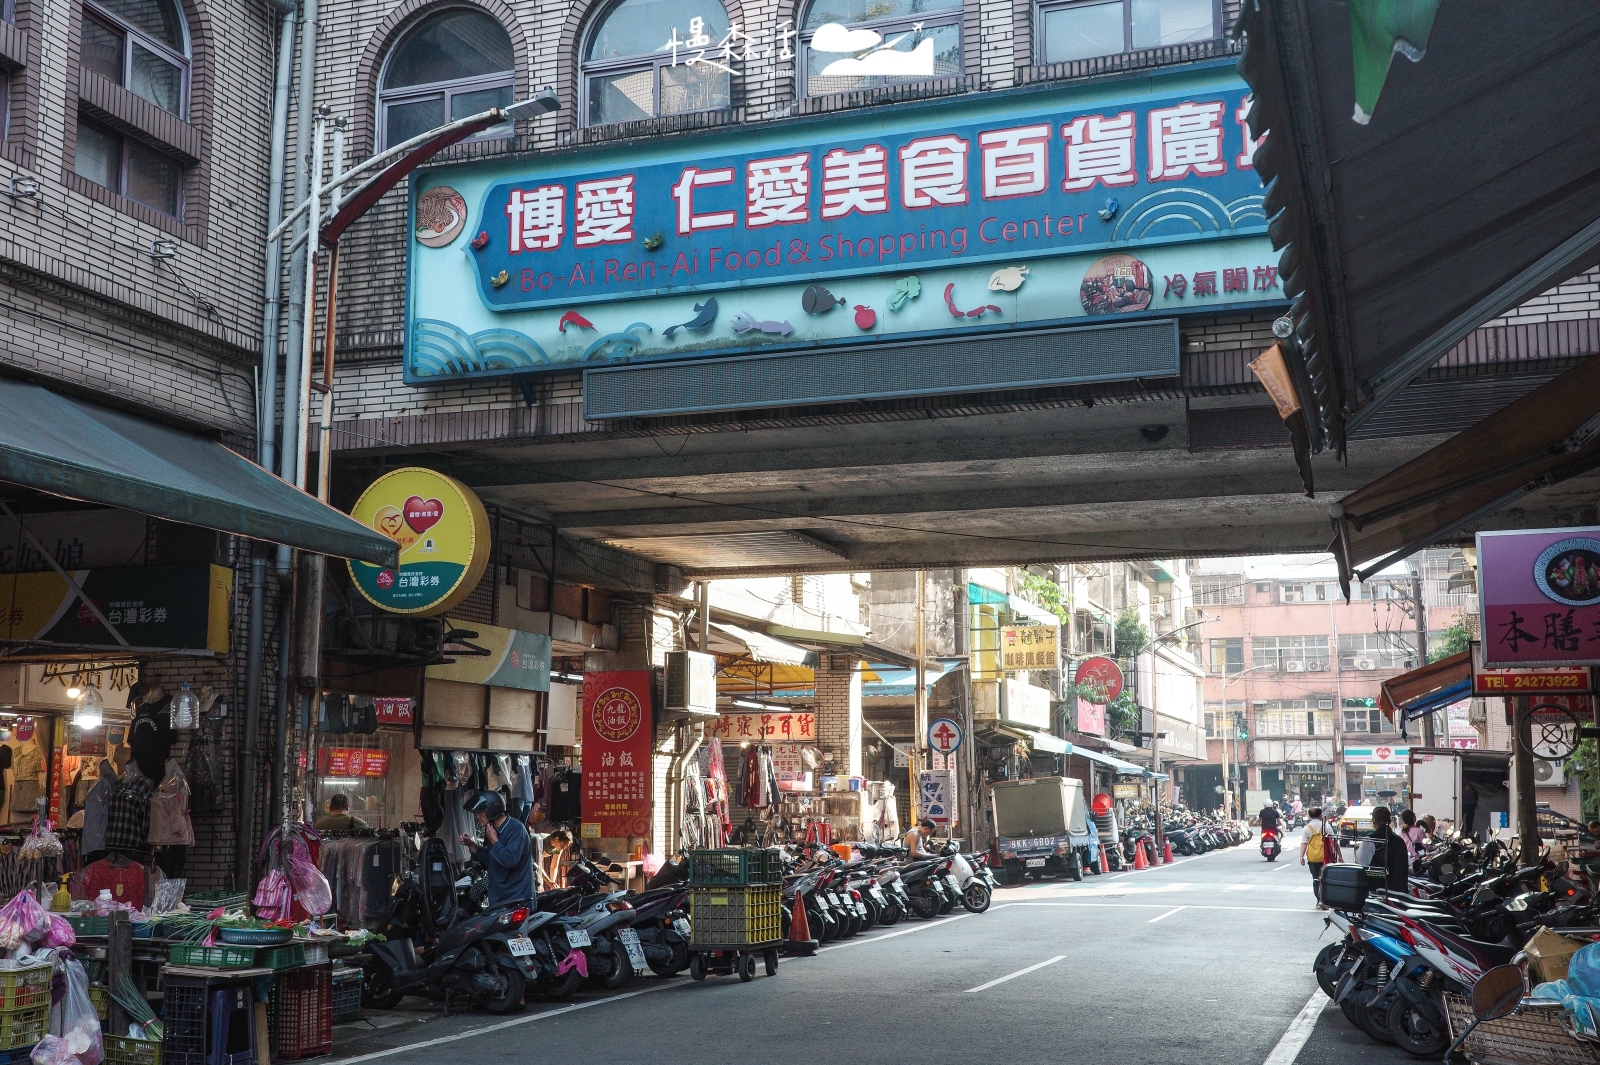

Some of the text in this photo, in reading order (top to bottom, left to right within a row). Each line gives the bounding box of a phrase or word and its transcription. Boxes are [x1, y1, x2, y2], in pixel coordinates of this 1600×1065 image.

[506, 174, 636, 255] 博愛
[521, 213, 1089, 292] Bo-Ai Ren-Ai Food & Shopping Center
[1163, 265, 1279, 298] 冷氣開放
[399, 575, 440, 588] 台灣彩券
[108, 607, 168, 625] 台灣彩券
[1485, 675, 1579, 688] TEL 24273922
[376, 703, 411, 718] 油飯
[602, 751, 634, 767] 油飯
[1011, 836, 1055, 849] BKK-6802
